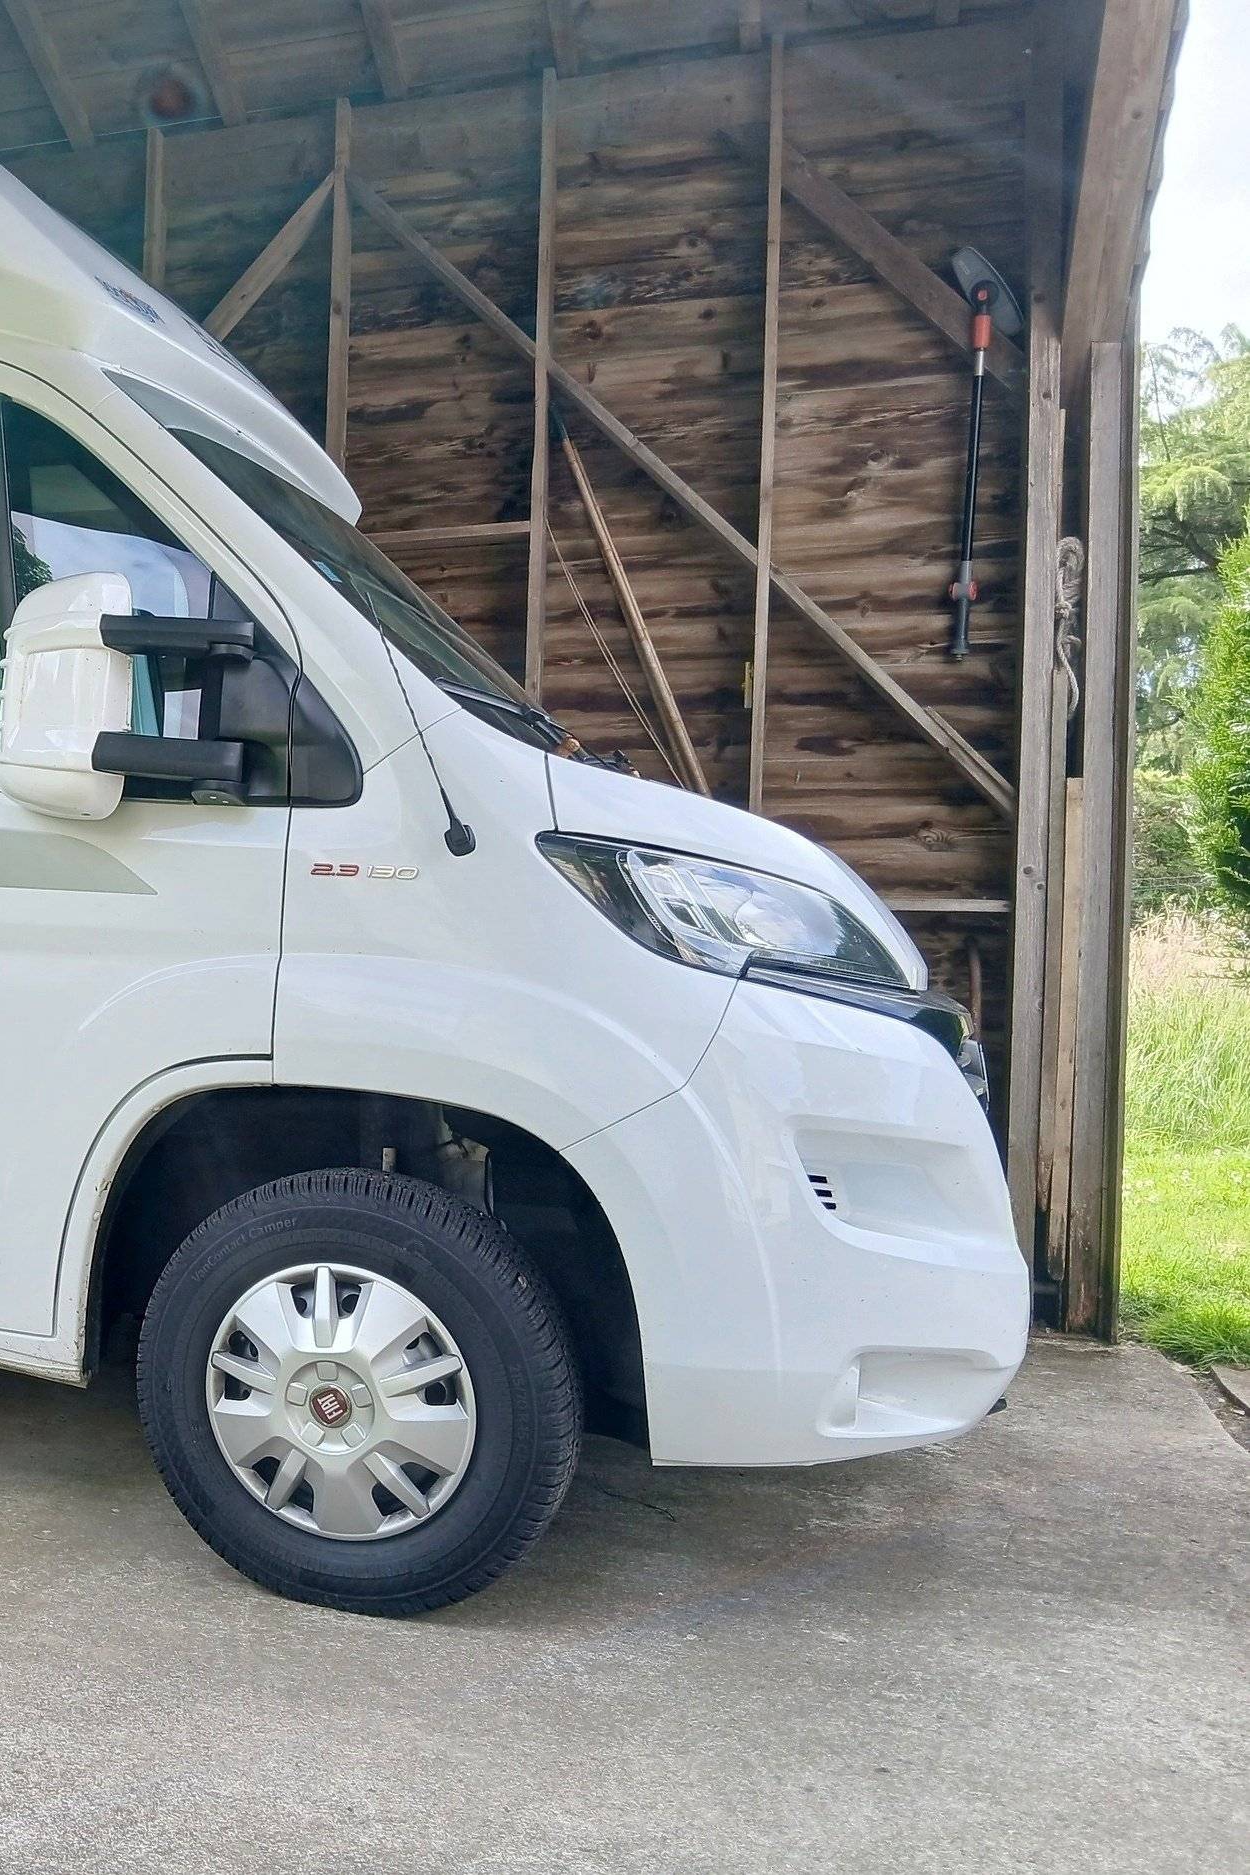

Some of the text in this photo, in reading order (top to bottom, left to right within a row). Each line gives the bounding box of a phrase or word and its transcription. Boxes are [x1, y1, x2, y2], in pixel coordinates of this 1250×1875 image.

[311, 863, 419, 881] 2.3 130
[248, 1217, 299, 1239] Camper
[316, 1393, 344, 1420] FIAT
